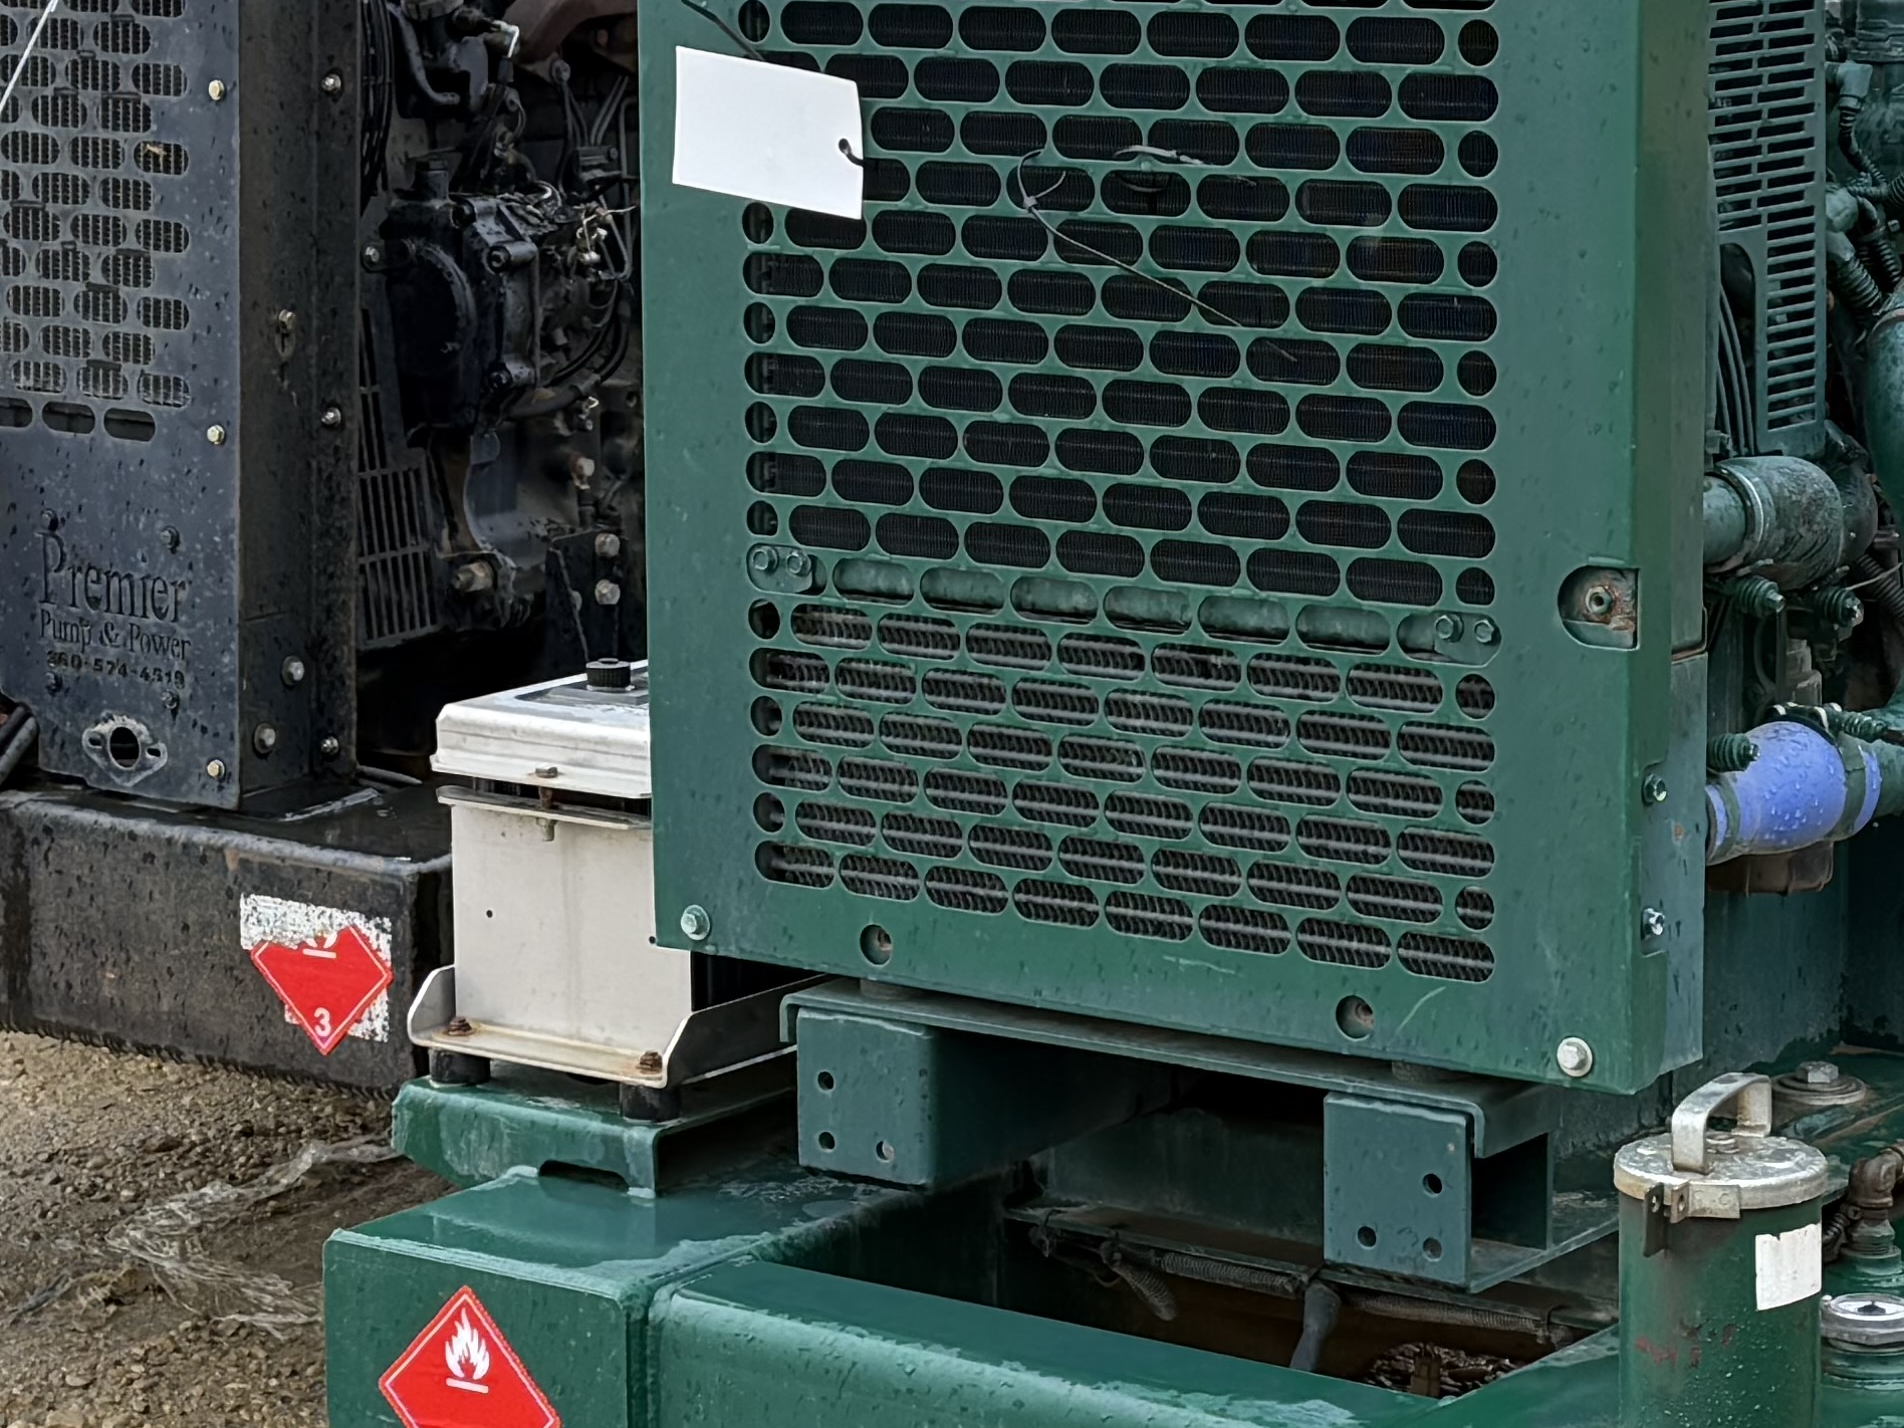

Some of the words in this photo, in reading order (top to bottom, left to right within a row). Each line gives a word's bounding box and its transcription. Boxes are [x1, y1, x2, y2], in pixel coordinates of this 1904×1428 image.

[34, 530, 193, 623] Premier
[39, 608, 92, 654] Pump
[127, 622, 192, 661] Power
[314, 1007, 332, 1039] 3
